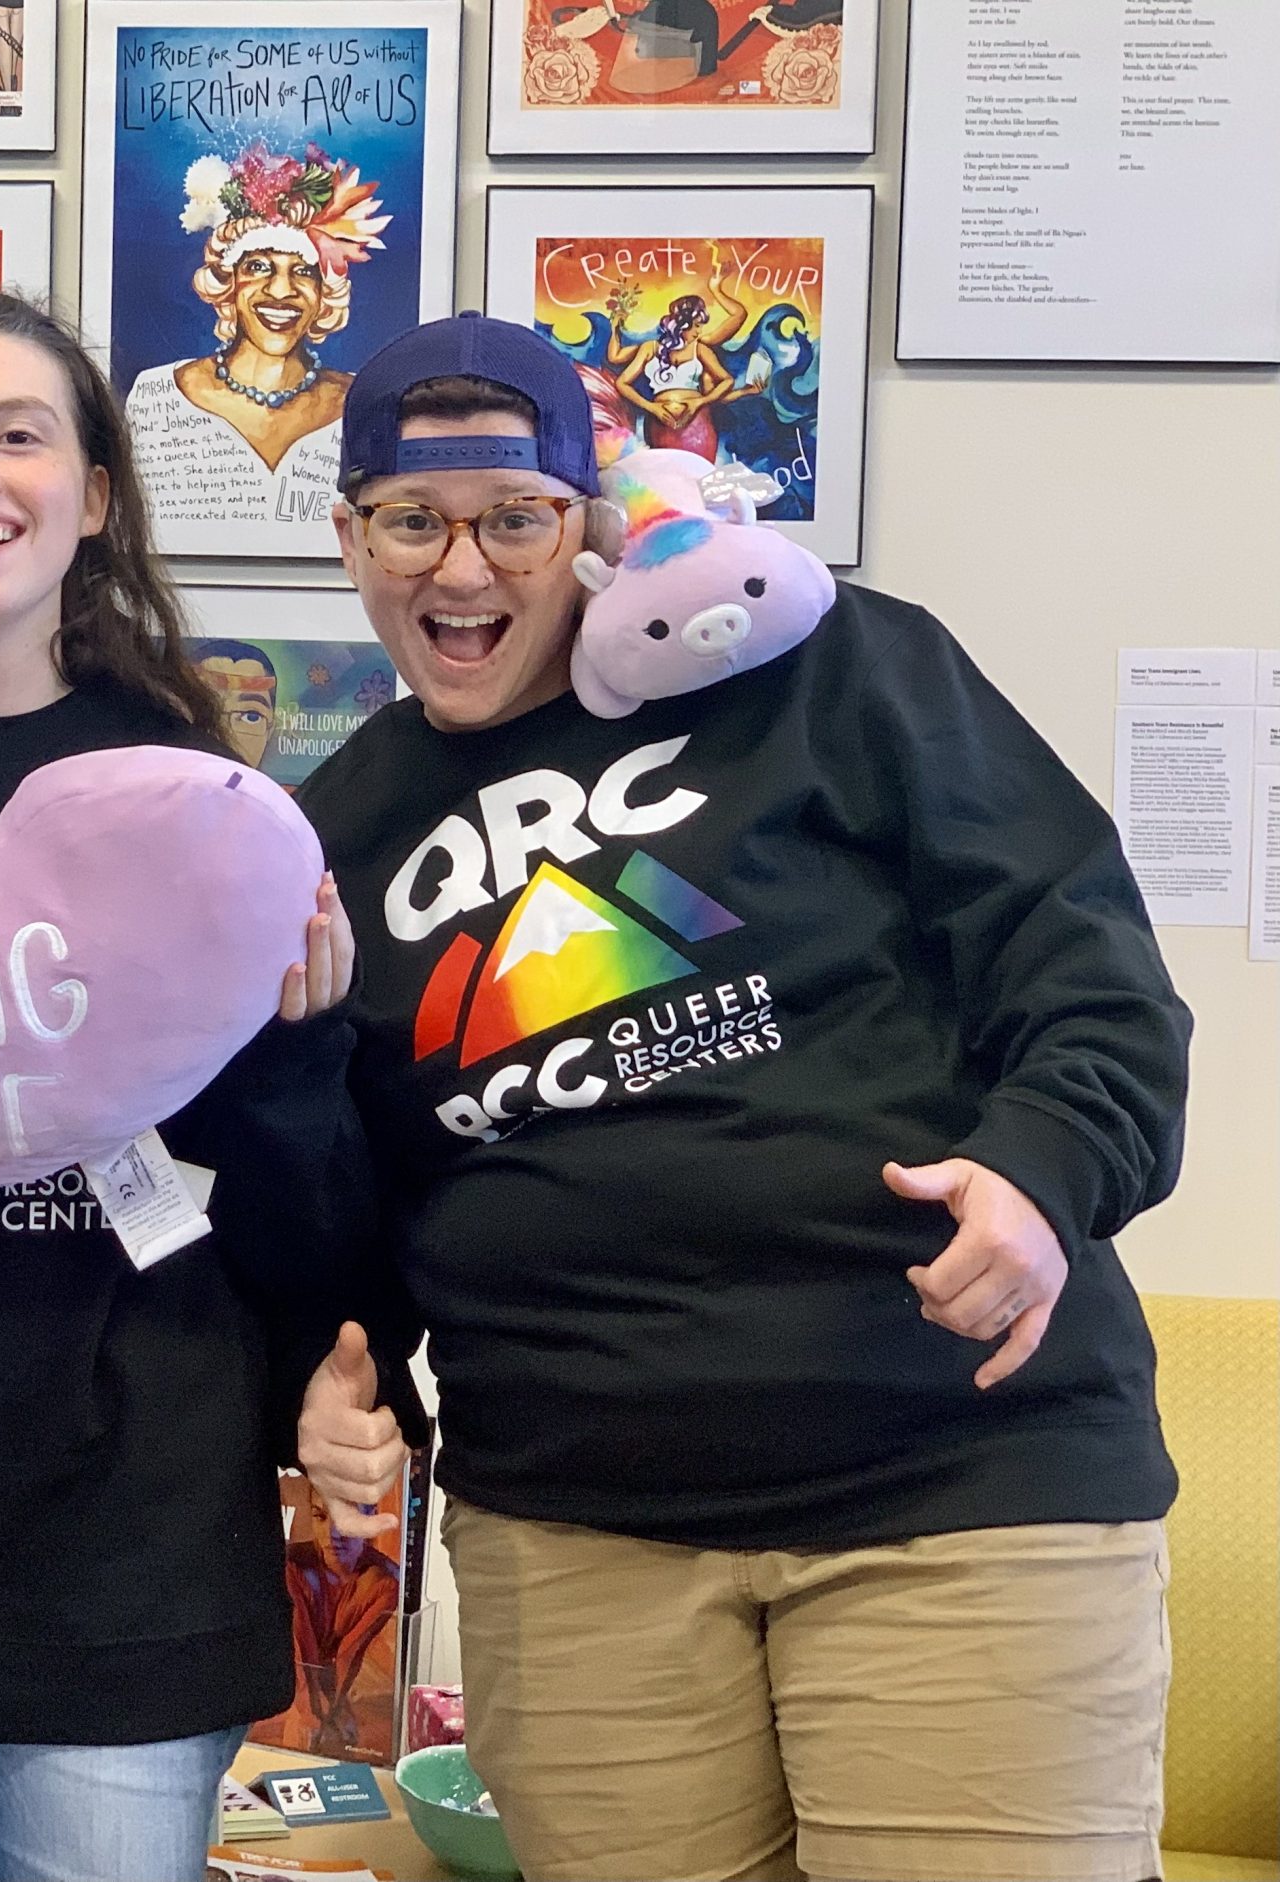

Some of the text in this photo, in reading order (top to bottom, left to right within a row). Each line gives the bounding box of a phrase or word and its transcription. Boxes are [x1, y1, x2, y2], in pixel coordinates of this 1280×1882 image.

[151, 41, 203, 70] PRIDE
[235, 39, 301, 69] SOME
[308, 43, 324, 65] of
[328, 39, 360, 66] US
[364, 39, 420, 64] without
[376, 74, 417, 126] US
[184, 464, 203, 475] She
[207, 461, 255, 475] dedicated
[299, 445, 340, 468] by Suppo
[159, 499, 176, 507] sex
[187, 478, 226, 493] helping
[276, 476, 330, 522] LIVE
[289, 712, 314, 731] WILL
[318, 714, 343, 732] LOVE
[384, 734, 709, 942] QRC
[607, 974, 772, 1047] QUEER
[615, 1004, 774, 1078] RESOURCE
[624, 1023, 782, 1093] CENTERS
